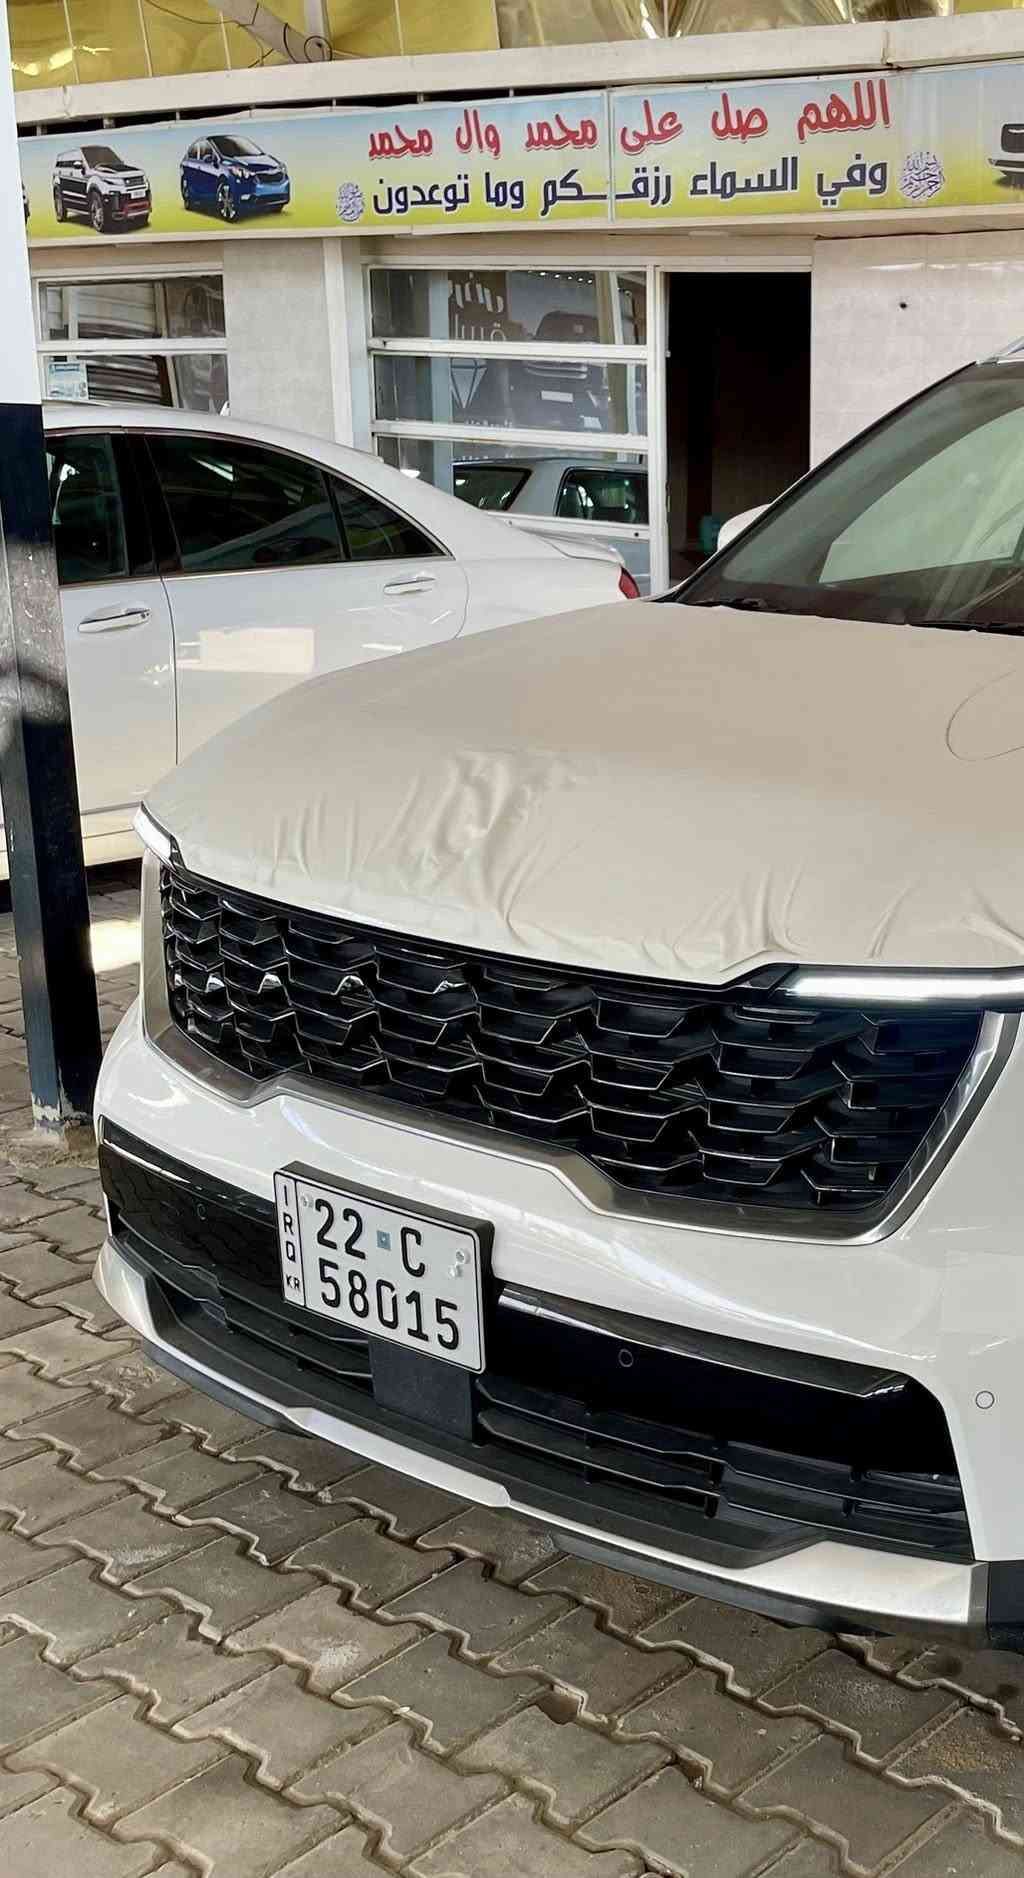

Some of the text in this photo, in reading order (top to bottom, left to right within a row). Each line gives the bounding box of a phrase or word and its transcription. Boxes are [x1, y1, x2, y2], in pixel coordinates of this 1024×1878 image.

[369, 79, 891, 159] اللهم صل على محمد وال محمد
[373, 174, 470, 215] توعدون
[484, 172, 524, 209] وما
[689, 157, 798, 199] السماء
[817, 153, 888, 206] وفي
[315, 1198, 425, 1278] 22 C
[286, 1274, 300, 1290] KR
[318, 1257, 460, 1351] 58015
